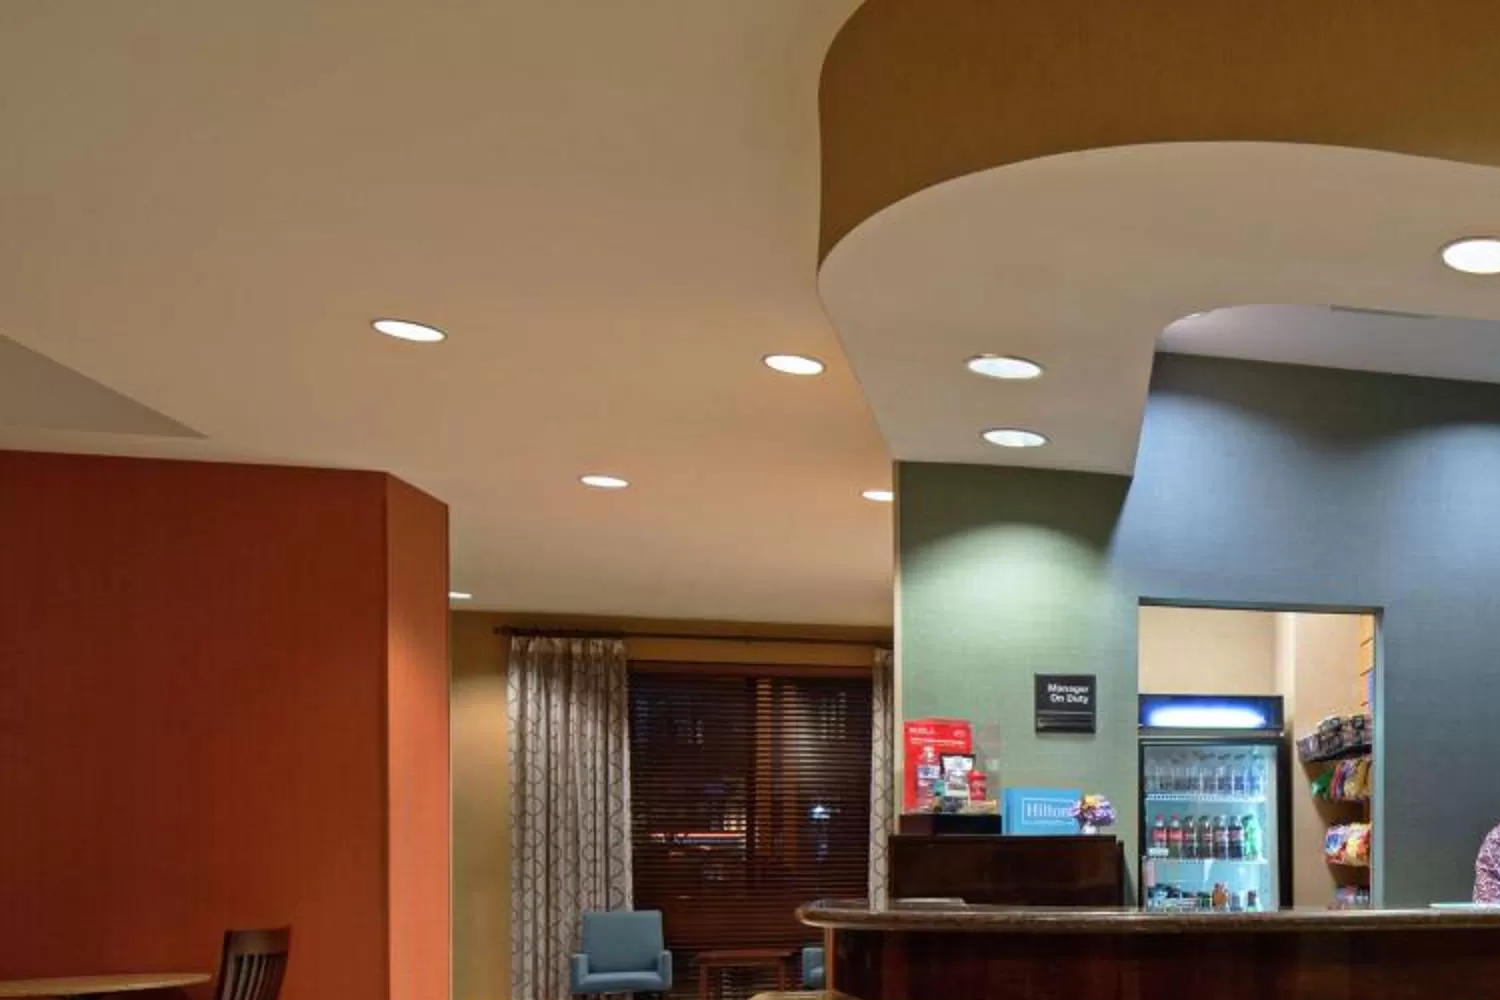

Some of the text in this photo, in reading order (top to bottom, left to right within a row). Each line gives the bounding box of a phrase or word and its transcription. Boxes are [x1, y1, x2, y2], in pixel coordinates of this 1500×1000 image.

[1047, 683, 1088, 695] Manager
[1050, 693, 1089, 705] On Duty
